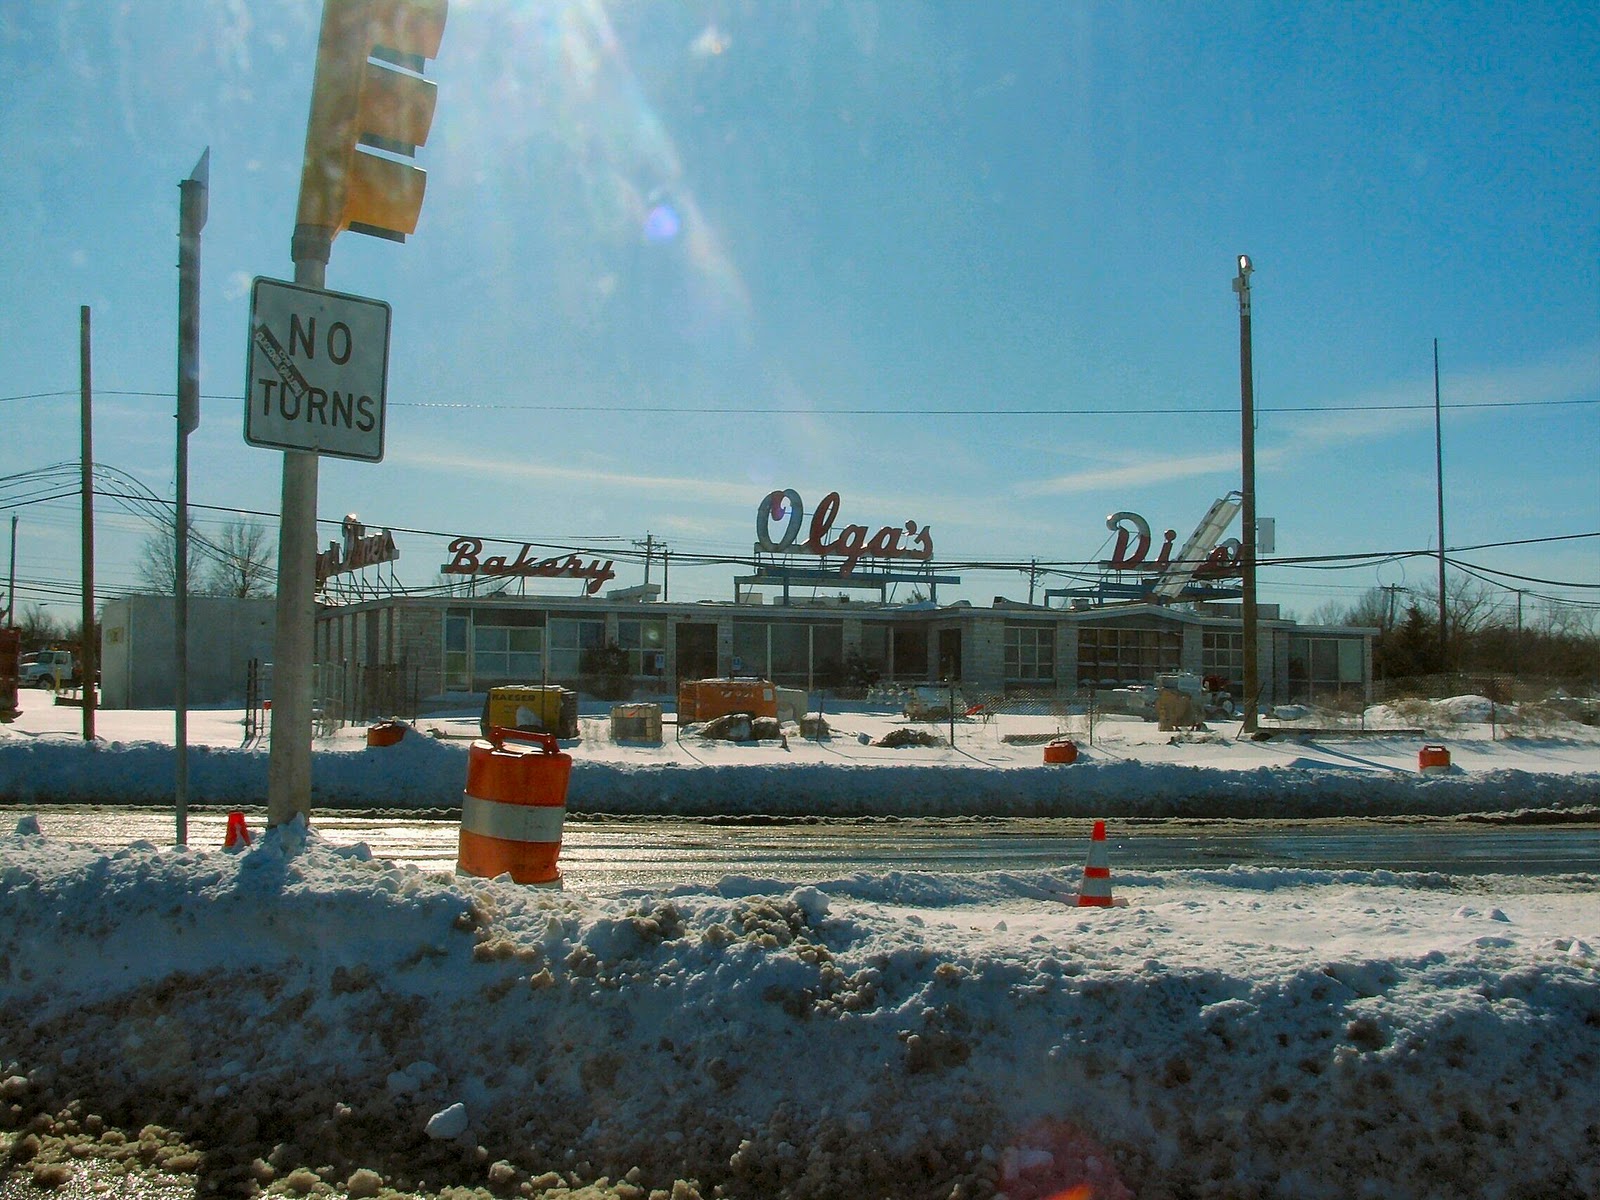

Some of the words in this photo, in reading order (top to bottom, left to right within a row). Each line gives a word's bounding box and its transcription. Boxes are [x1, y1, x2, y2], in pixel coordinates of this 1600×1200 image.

[289, 313, 352, 365] NO
[258, 378, 375, 432] TURNS
[756, 488, 934, 578] Olga's
[447, 536, 615, 594] Bakery
